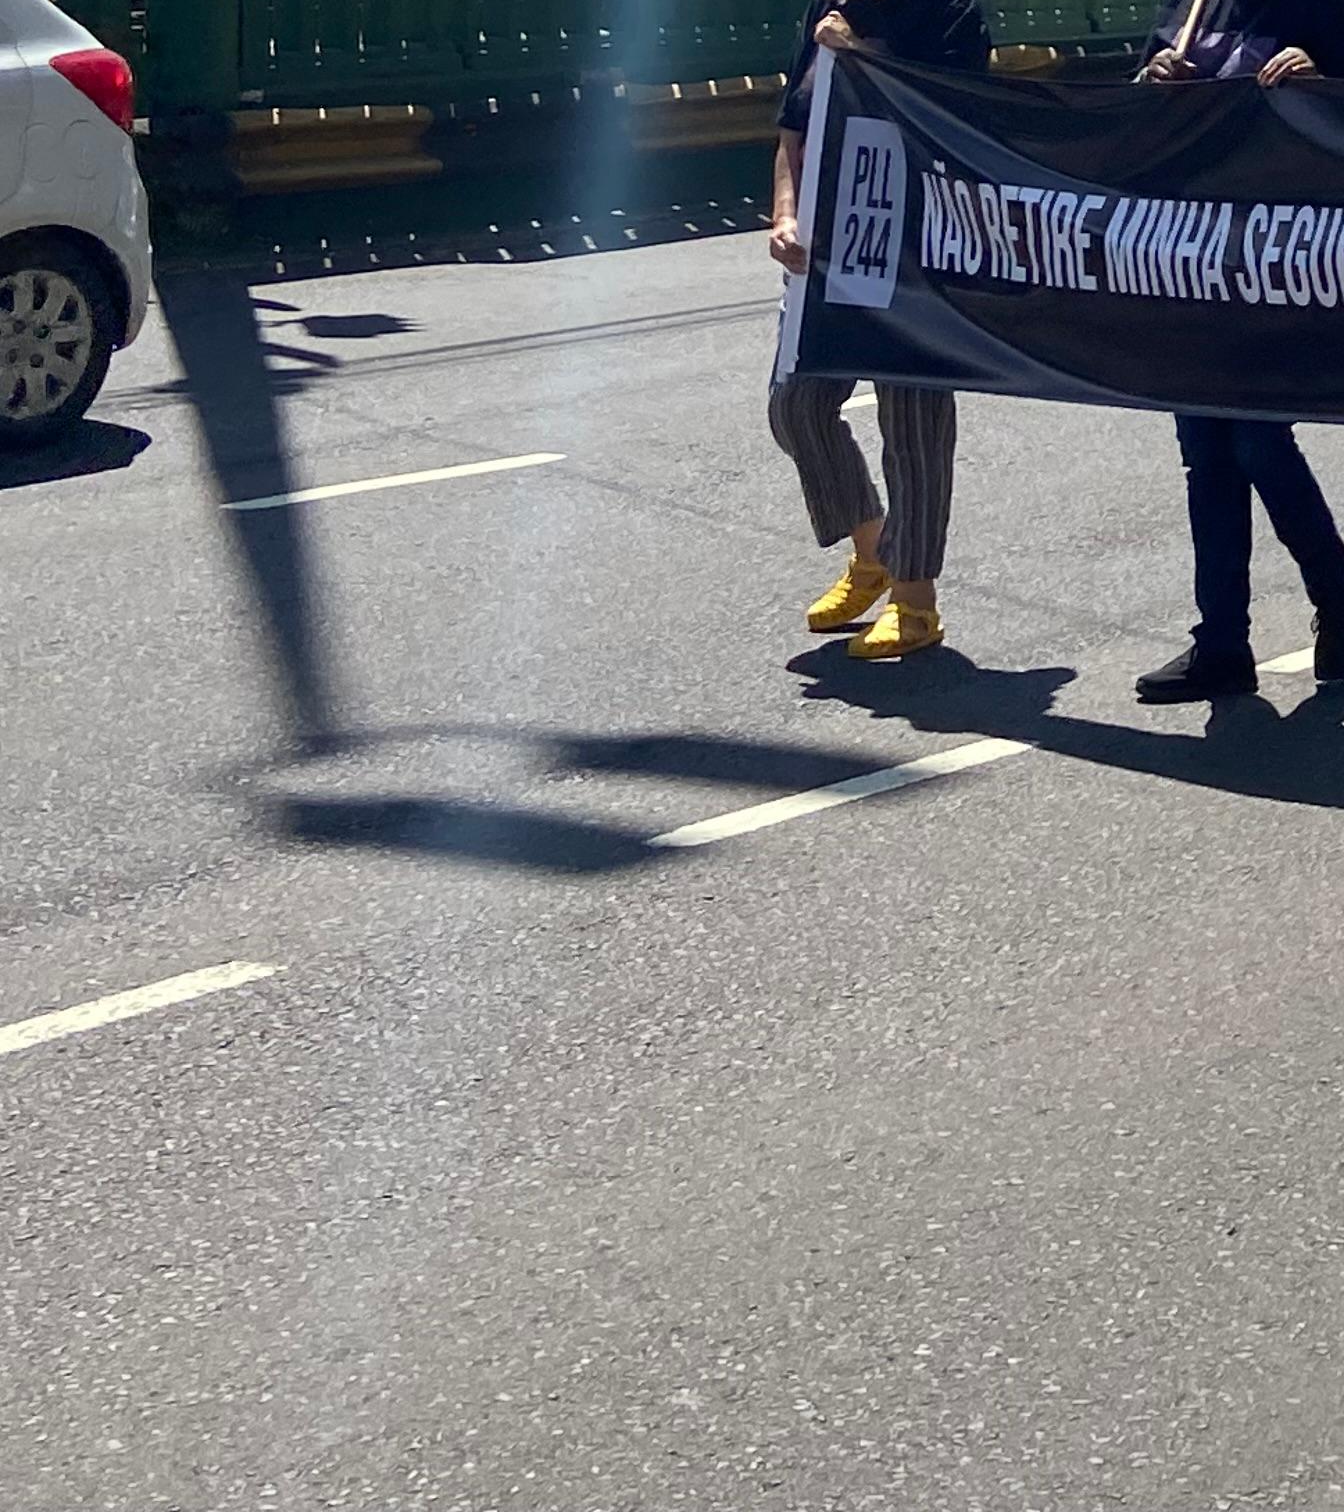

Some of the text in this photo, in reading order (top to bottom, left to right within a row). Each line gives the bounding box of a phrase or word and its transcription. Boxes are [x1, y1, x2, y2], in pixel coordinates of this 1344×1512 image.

[850, 145, 893, 210] PLL
[840, 212, 892, 279] 244
[920, 159, 983, 276] NÃO
[978, 183, 1107, 291] RETIRE
[1104, 197, 1233, 302] MINHA
